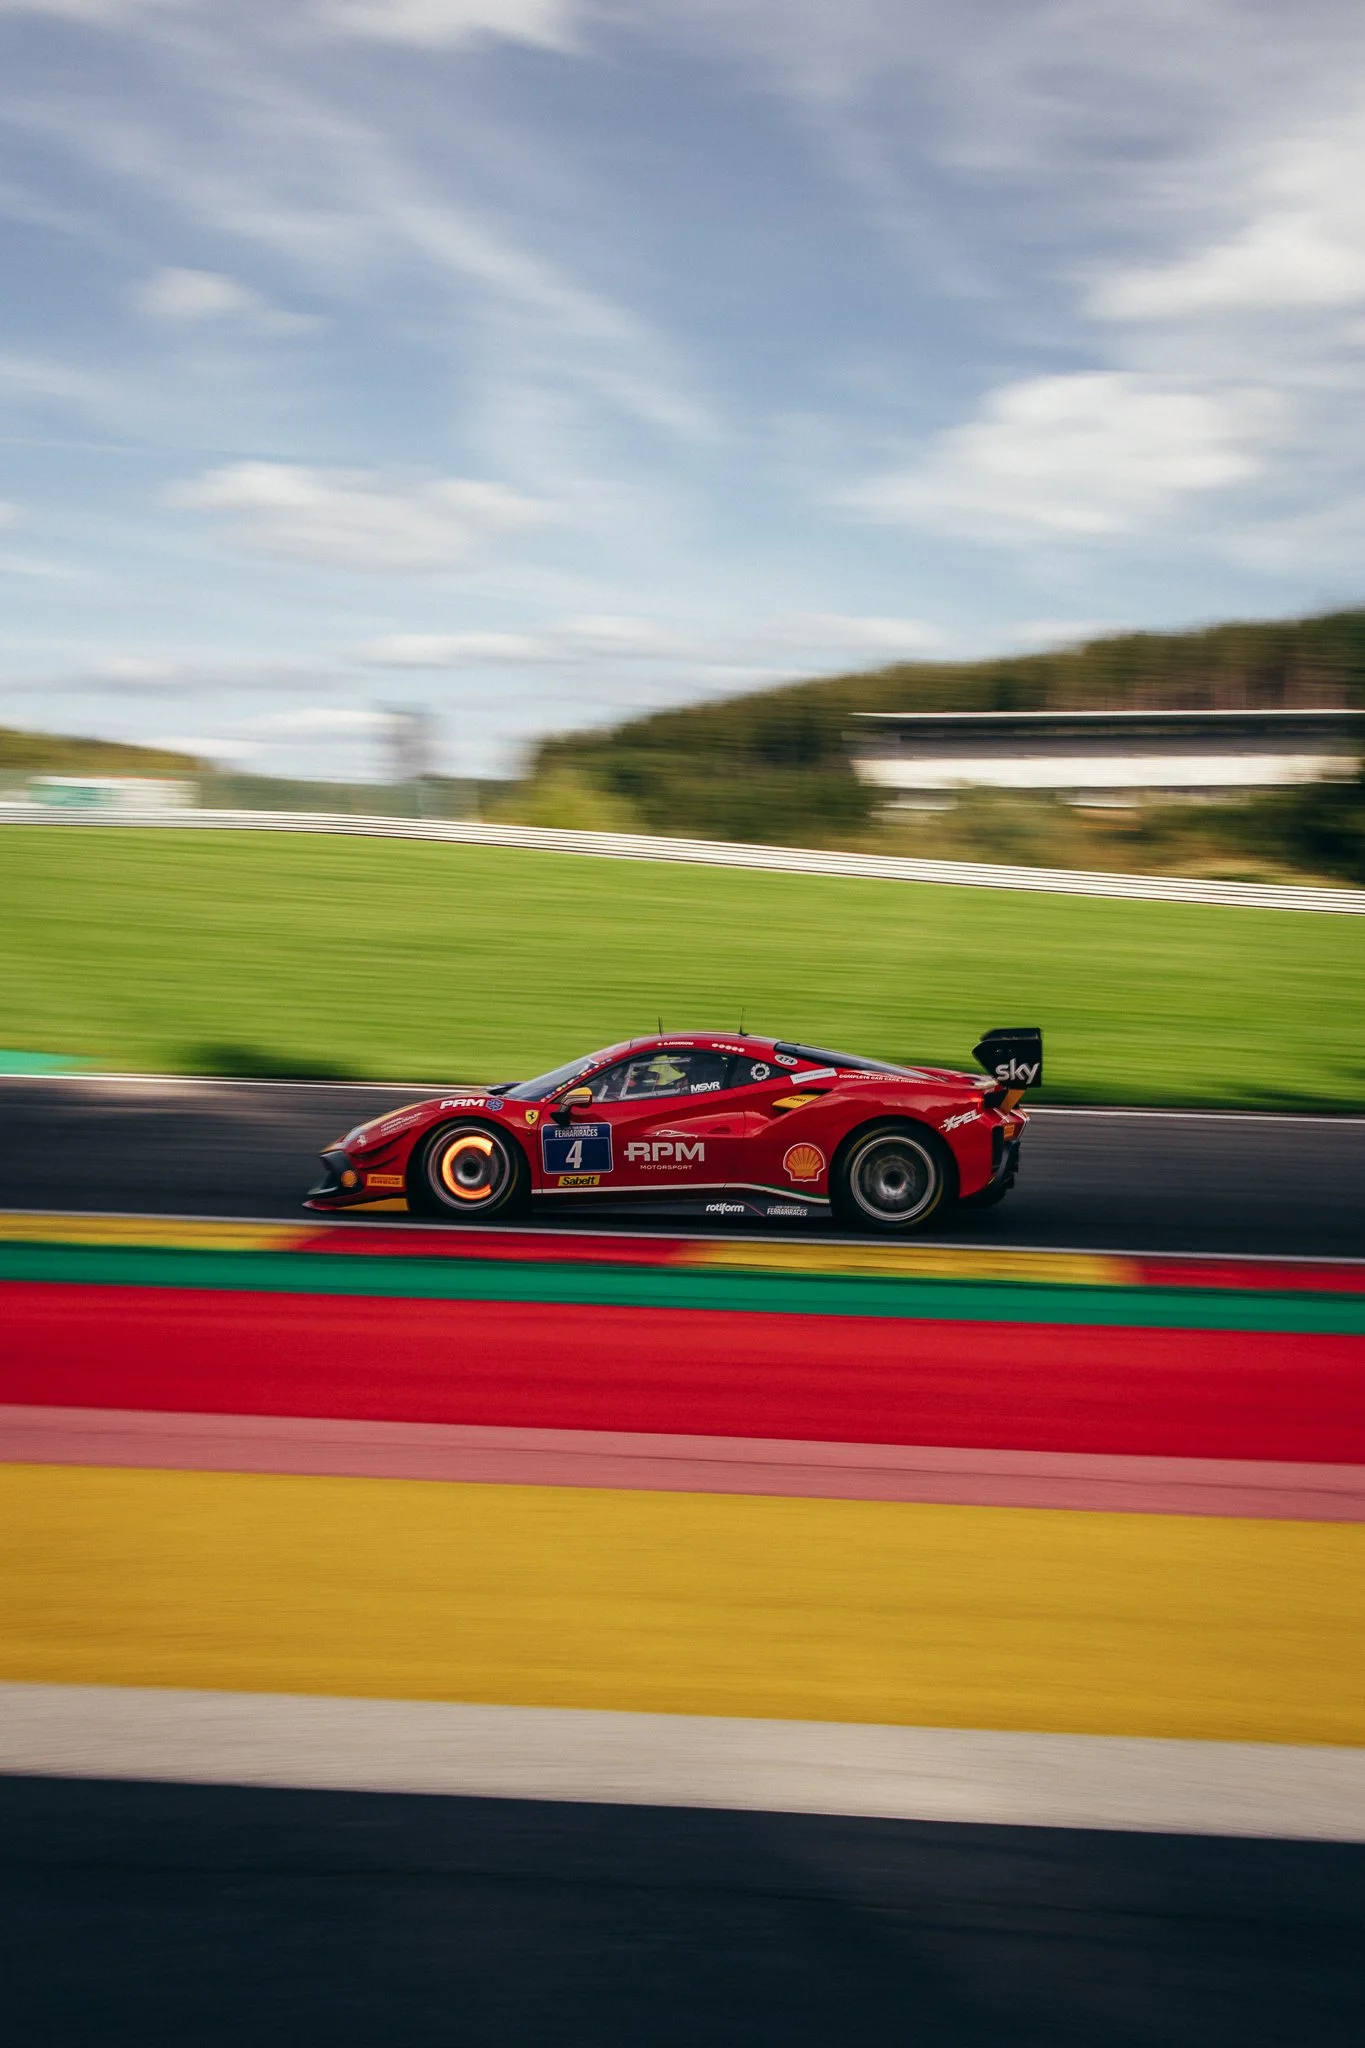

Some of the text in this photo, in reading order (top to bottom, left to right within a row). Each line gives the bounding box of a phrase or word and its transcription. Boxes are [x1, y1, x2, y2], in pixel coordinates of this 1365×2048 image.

[995, 1058, 1040, 1085] sky
[690, 1081, 721, 1094] MSVR
[440, 1098, 486, 1110] PRM
[943, 1109, 982, 1133] XPEL
[565, 1140, 583, 1169] 4
[623, 1142, 705, 1162] RPM
[562, 1176, 596, 1186] Sabelt
[705, 1203, 745, 1215] rotiform
